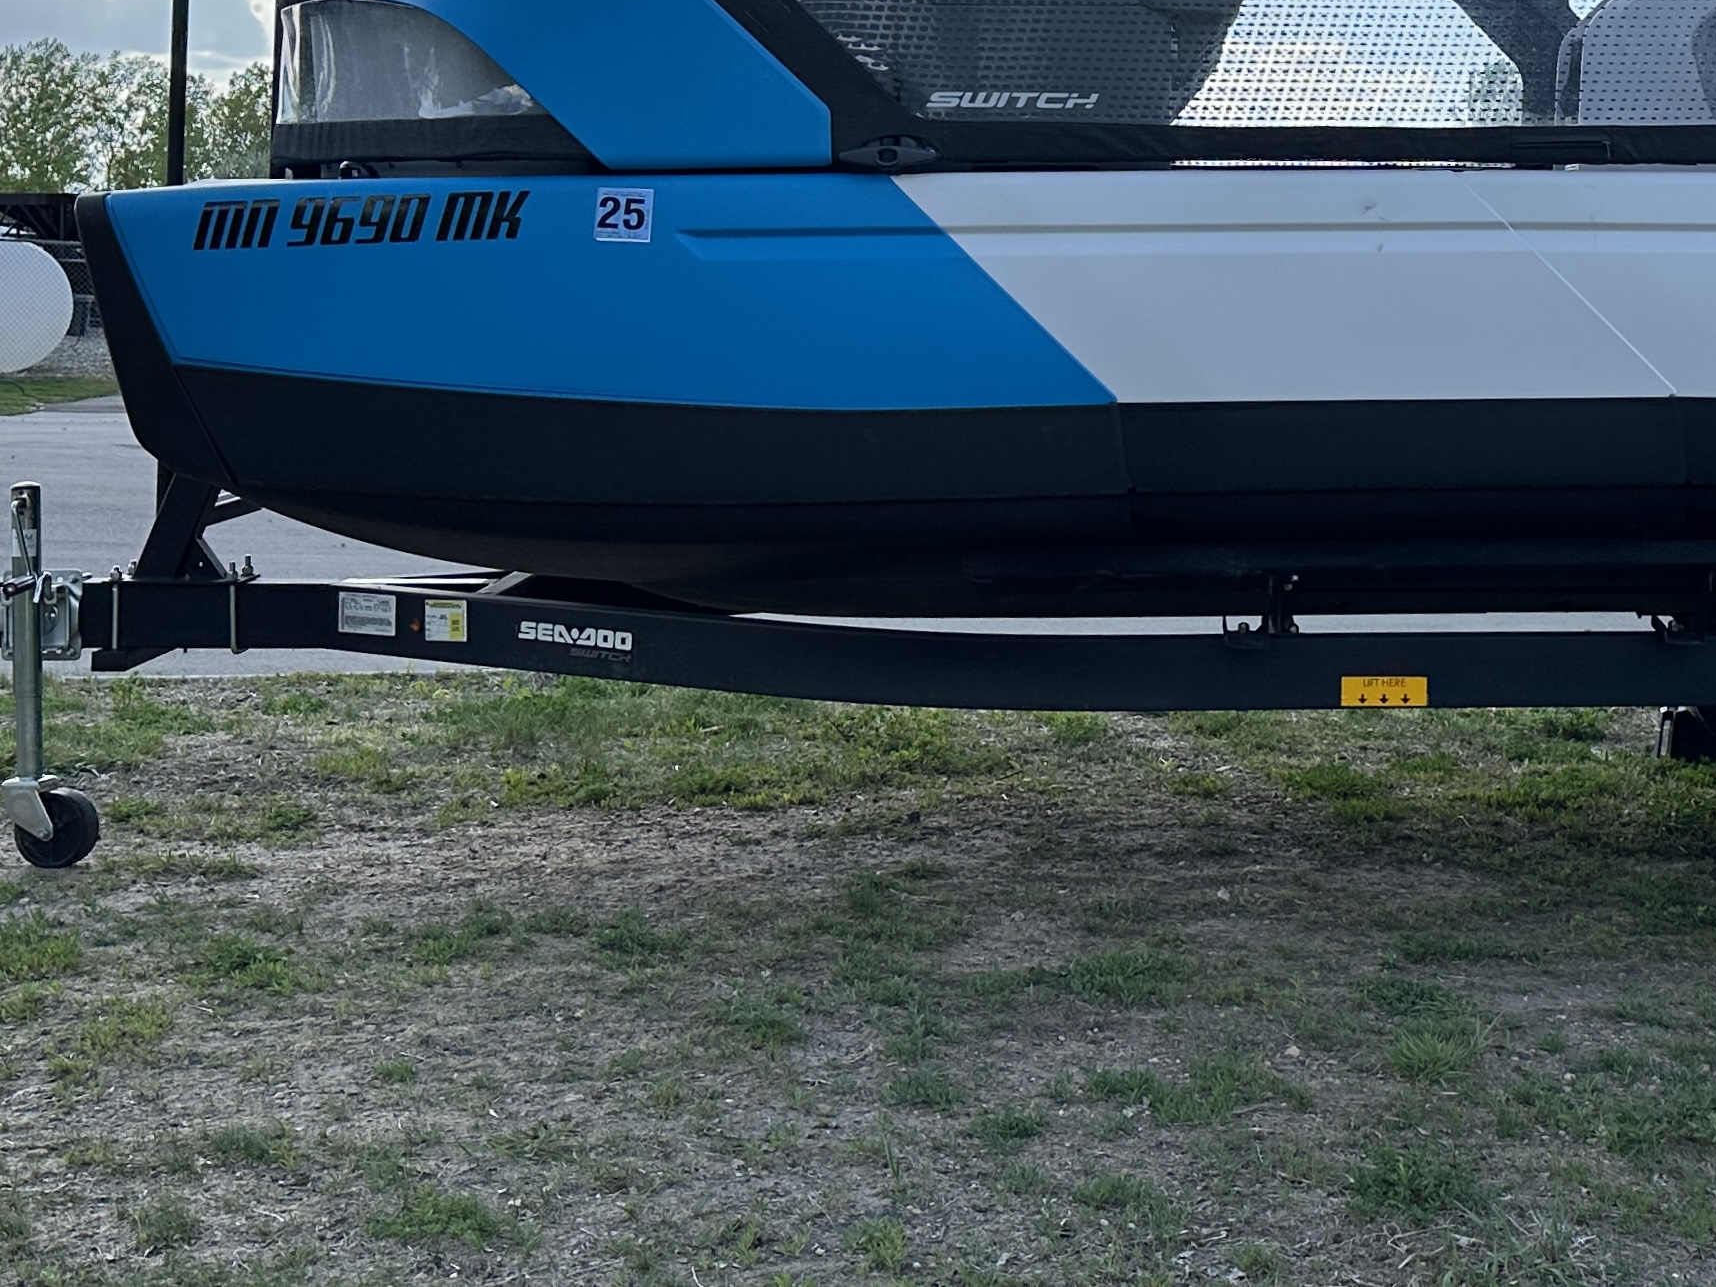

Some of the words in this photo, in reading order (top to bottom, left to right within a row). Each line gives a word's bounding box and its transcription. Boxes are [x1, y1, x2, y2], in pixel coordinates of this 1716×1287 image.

[926, 91, 1099, 109] SWITCH
[286, 193, 431, 247] 9690
[435, 190, 531, 242] MK
[597, 196, 646, 231] 25
[569, 647, 632, 663] SWITCH
[1362, 677, 1380, 688] LIFT
[1381, 677, 1407, 688] HERE
